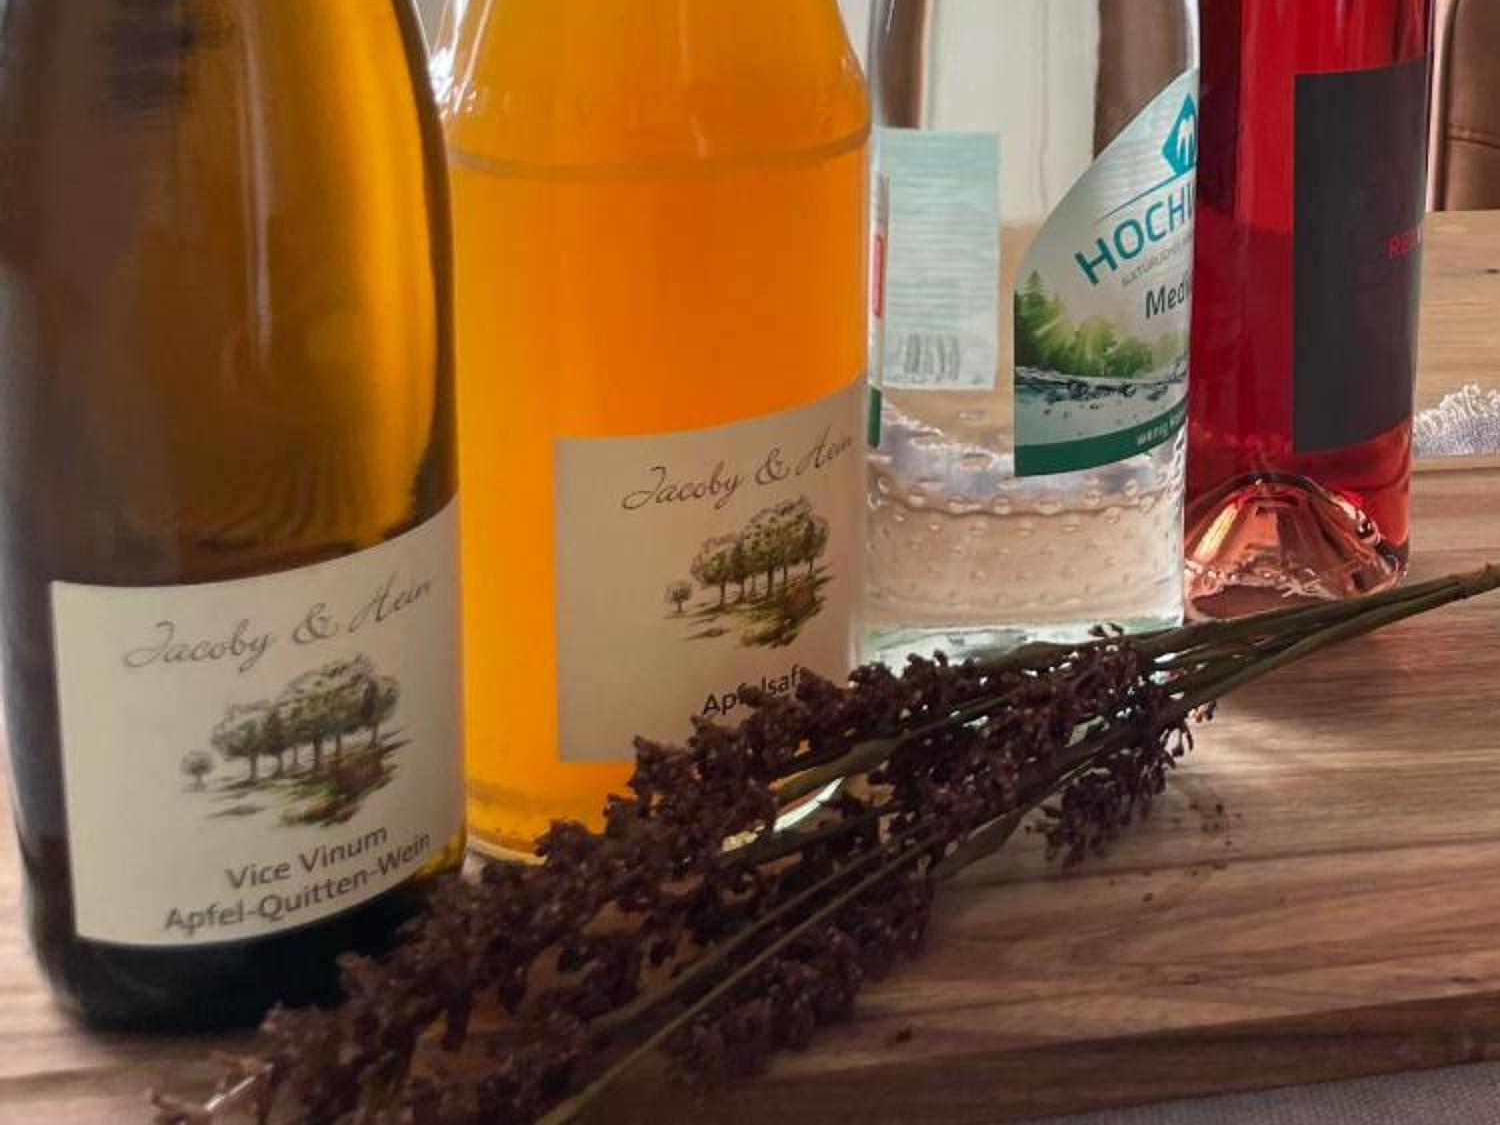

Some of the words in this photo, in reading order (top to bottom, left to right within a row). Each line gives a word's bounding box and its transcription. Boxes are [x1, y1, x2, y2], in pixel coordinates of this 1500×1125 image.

[622, 459, 743, 511] Jacoby
[755, 447, 788, 485] &
[124, 618, 275, 673] Jacoby
[292, 603, 339, 645] &
[163, 833, 432, 936] Apfel-Quitten-Wein
[226, 861, 291, 890] Vice
[298, 826, 388, 874] Vinum
